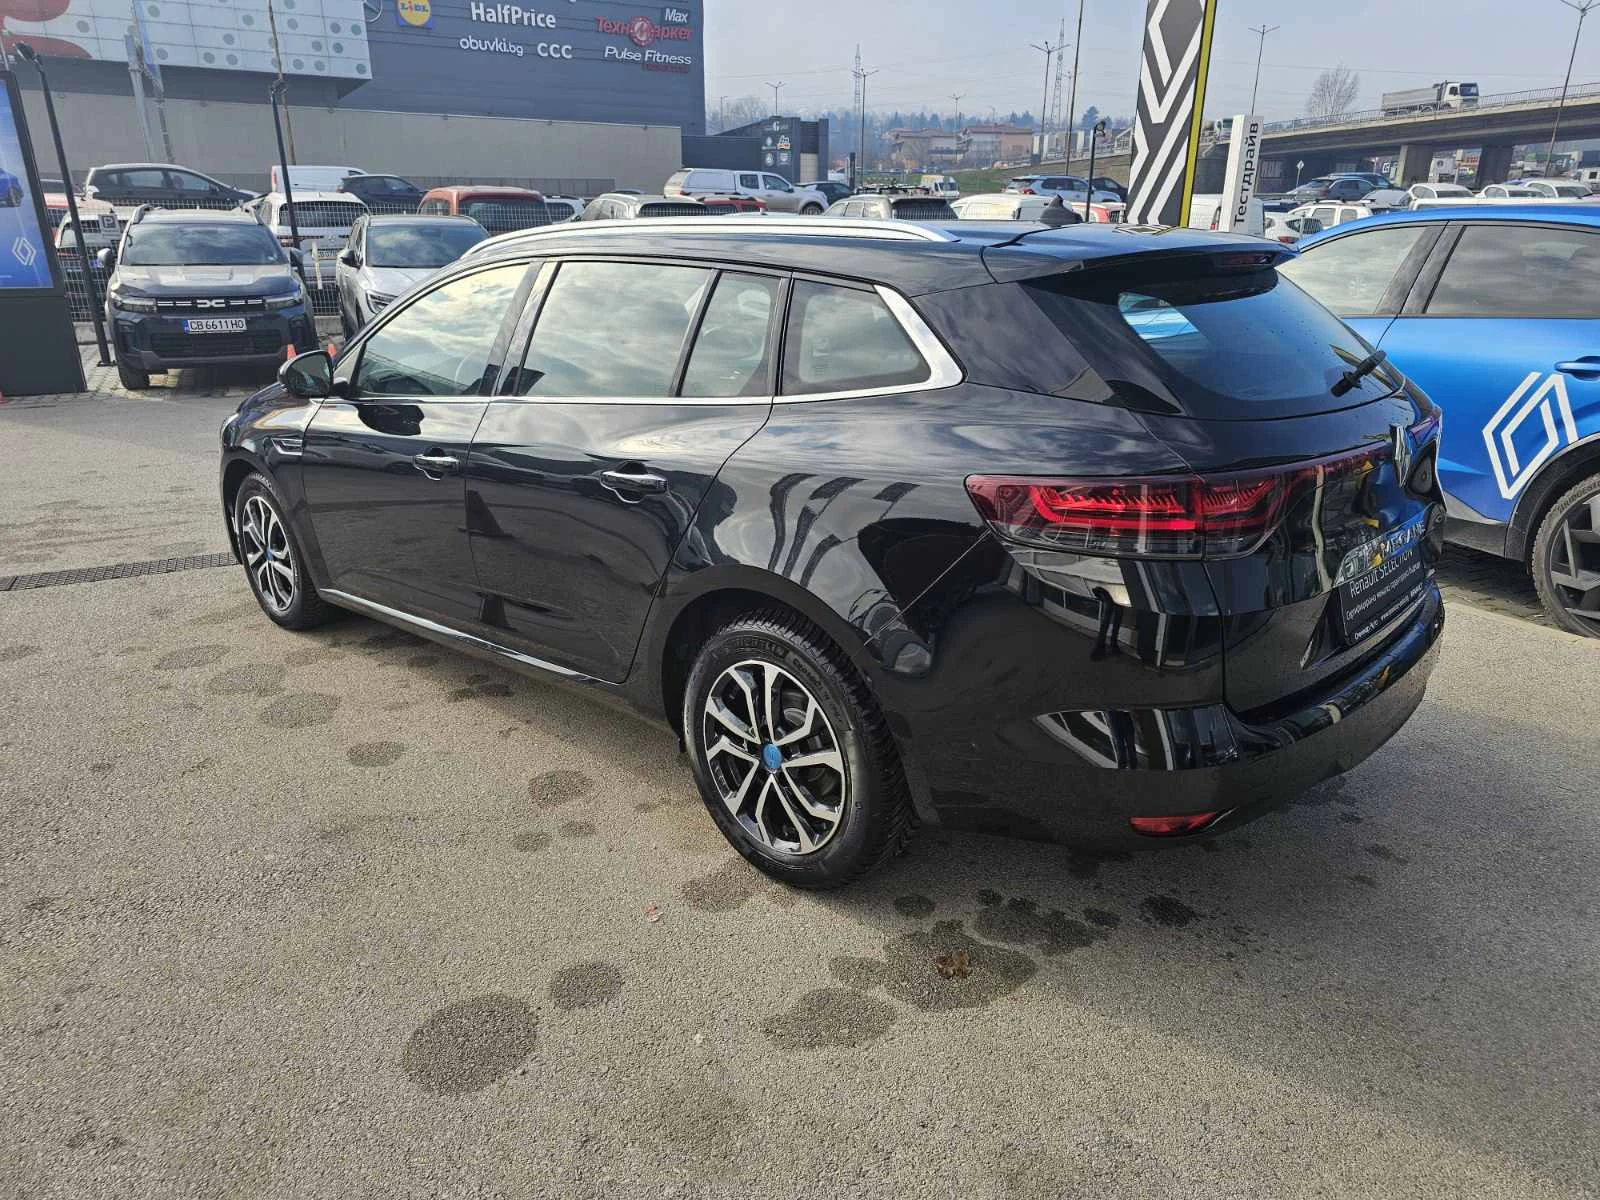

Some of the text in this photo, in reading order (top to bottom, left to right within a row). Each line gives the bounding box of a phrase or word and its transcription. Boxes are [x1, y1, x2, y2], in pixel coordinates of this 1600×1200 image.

[470, 2, 556, 28] HalfPrice
[665, 8, 688, 23] Max
[460, 35, 523, 56] obuvki.bg
[537, 42, 573, 59] CCC
[604, 46, 692, 65] Pulse Fitness
[1233, 122, 1259, 227] Тестдрайв
[190, 319, 244, 330] CB 6611 HO
[1349, 569, 1379, 598] Renault
